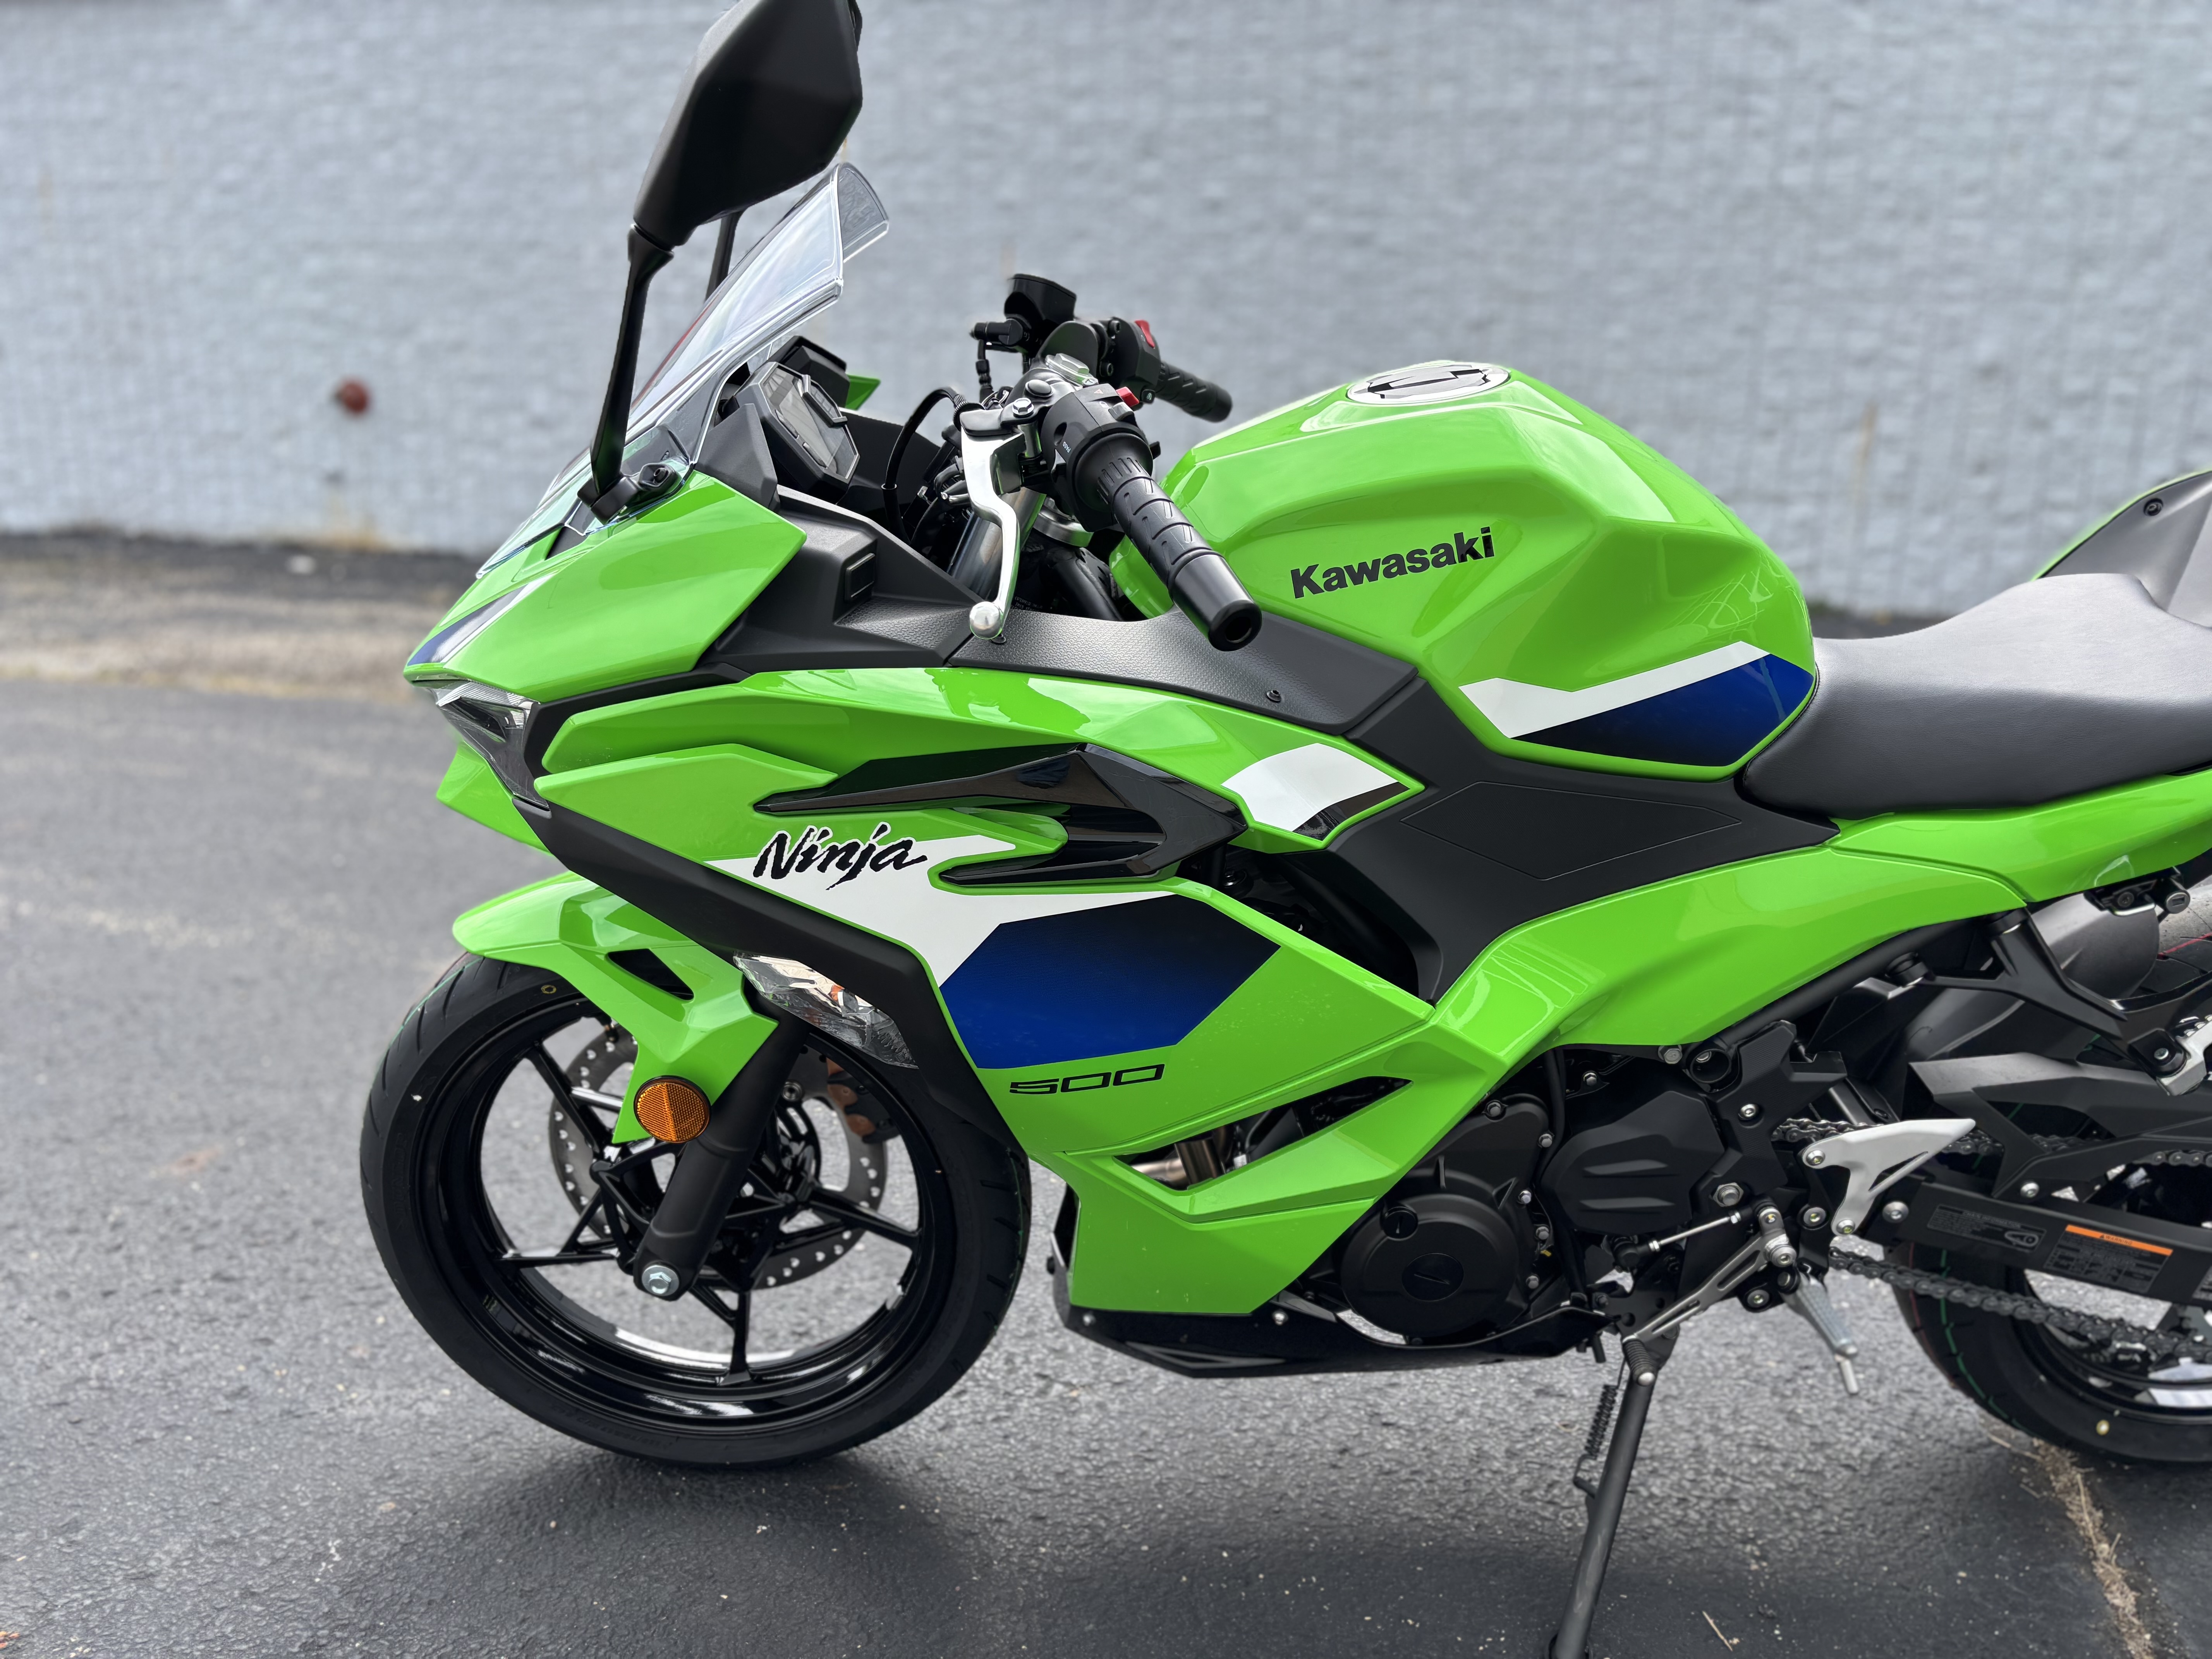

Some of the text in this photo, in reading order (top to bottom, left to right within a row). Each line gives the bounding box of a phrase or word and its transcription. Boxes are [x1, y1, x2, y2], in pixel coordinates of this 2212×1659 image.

[1290, 526, 1495, 599] Kawasaki
[752, 824, 928, 891] Ninja
[1009, 1063, 1165, 1094] 500
[2105, 1235, 2133, 1245] WARNING
